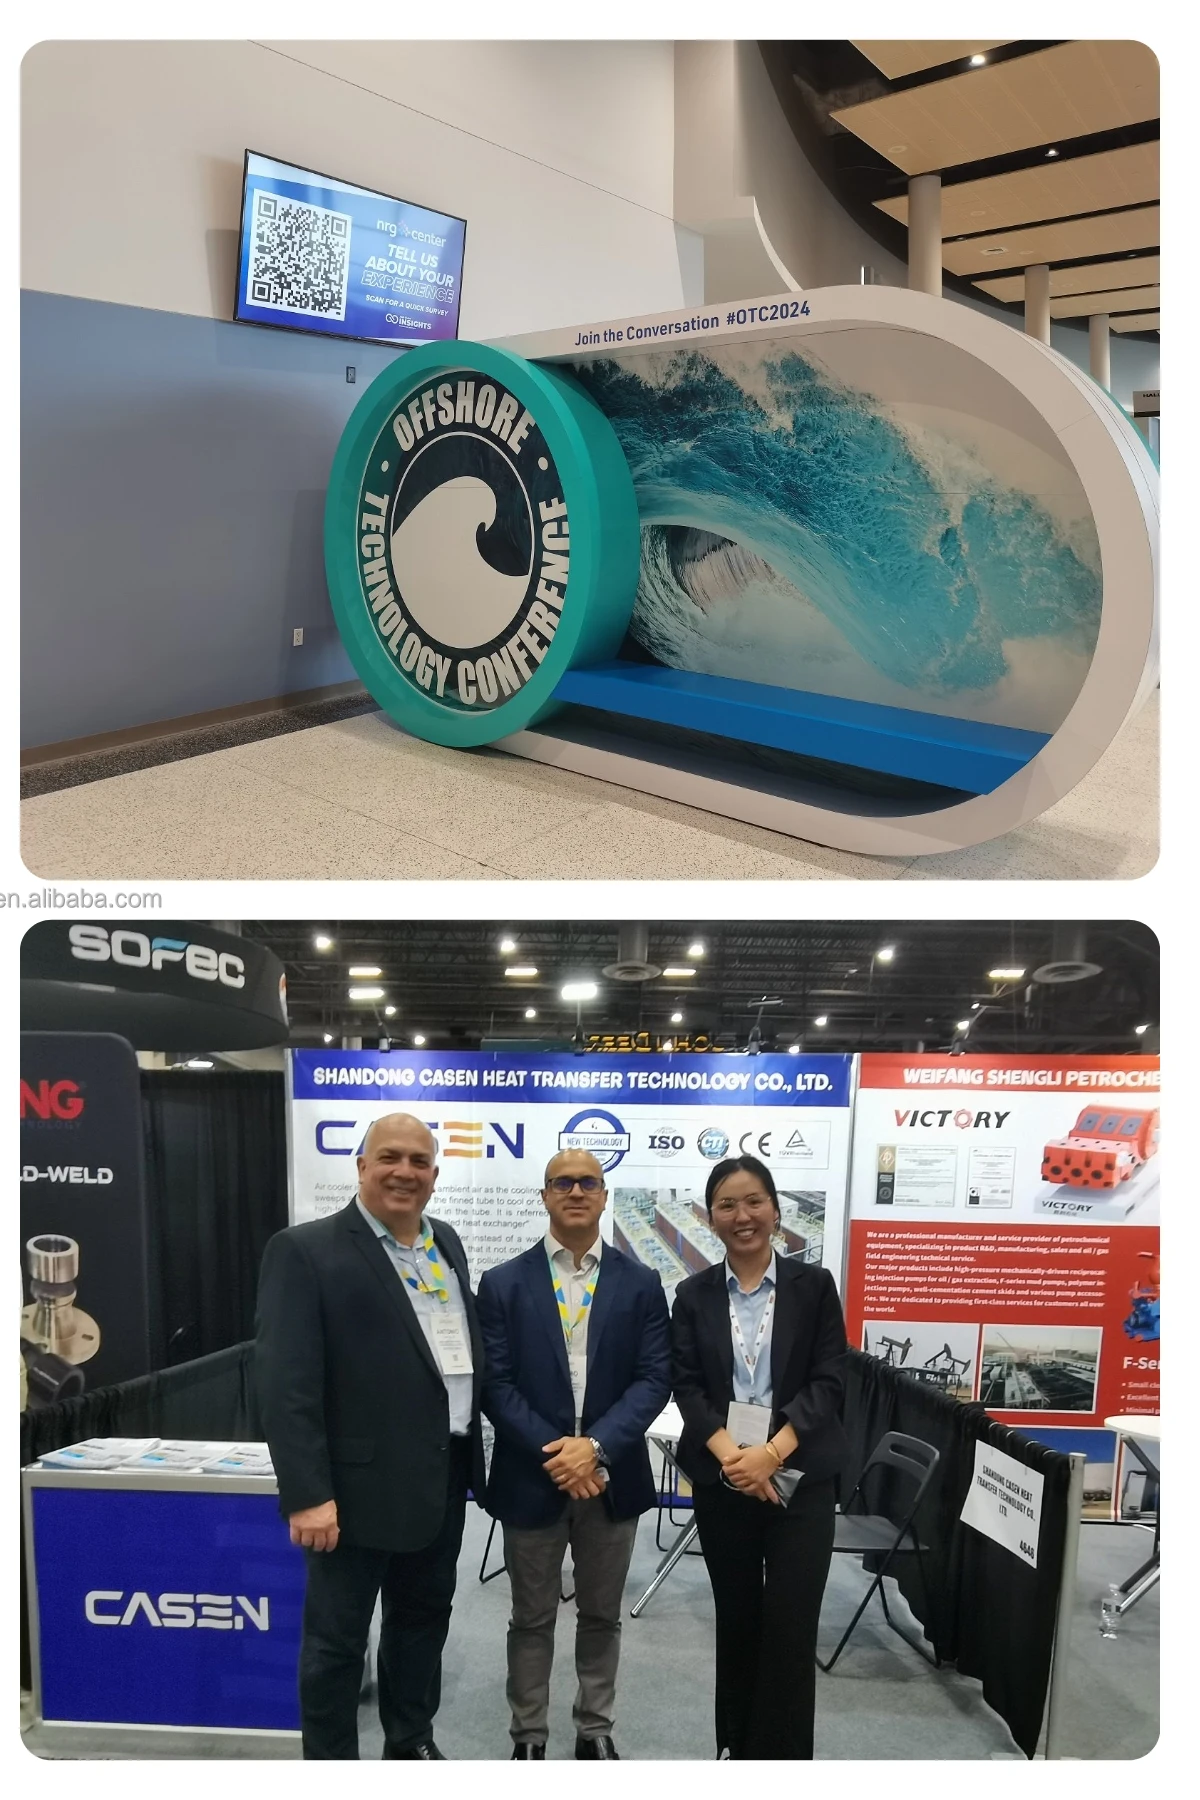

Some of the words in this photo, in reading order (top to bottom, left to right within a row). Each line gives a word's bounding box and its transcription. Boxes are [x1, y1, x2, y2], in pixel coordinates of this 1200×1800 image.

[376, 219, 397, 238] nrg
[411, 229, 446, 247] center
[388, 244, 417, 263] TELL
[421, 252, 439, 268] US
[365, 255, 416, 279] ABOUT
[419, 267, 454, 288] YOUR
[361, 270, 455, 304] EXPERIENCE
[365, 294, 384, 305] SCAN
[385, 298, 399, 307] FOR
[405, 302, 425, 312] QUICK
[426, 306, 449, 317] SURVEY
[575, 332, 600, 346] Join
[603, 328, 624, 343] the
[626, 316, 720, 340] Conversation
[726, 301, 811, 325] #OTC2024
[393, 380, 535, 455] OFFSHORE
[361, 489, 452, 698] TECHNOLOGY
[457, 496, 570, 706] CONFERENCE
[313, 1067, 415, 1087] SHANDONG
[419, 1068, 478, 1087] CASEN
[483, 1070, 527, 1087] HEAT
[531, 1070, 623, 1088] TRANSFER
[627, 1072, 751, 1090] TECHNOLOGY
[754, 1073, 792, 1094] CO.,
[796, 1074, 833, 1091] LTD.
[903, 1068, 983, 1084] WEIFANG
[986, 1068, 1062, 1086] SHENGLI
[894, 1108, 1011, 1129] VICTORY
[315, 1120, 525, 1159] CEN
[567, 1138, 580, 1146] NEW
[583, 1138, 623, 1147] TECHNOLOGY
[649, 1135, 685, 1150] ISO
[702, 1135, 724, 1149] CTI
[739, 1131, 772, 1157] CE
[438, 1185, 470, 1193] ambient
[496, 1186, 509, 1194] the
[511, 1187, 541, 1196] cooling
[449, 1196, 474, 1204] finned
[477, 1197, 495, 1205] tube
[507, 1197, 524, 1205] cool
[1042, 1200, 1093, 1212] VICTORY
[456, 1207, 469, 1215] the
[517, 1209, 549, 1217] referred
[463, 1219, 481, 1227] heat
[473, 1234, 501, 1242] instead
[1022, 1235, 1052, 1243] provider
[468, 1245, 483, 1253] that
[866, 1242, 904, 1250] equipment,
[905, 1243, 944, 1251] specializing
[998, 1245, 1049, 1254] manufacturing,
[882, 1253, 920, 1261] engineering
[905, 1275, 927, 1283] pumps
[1001, 1267, 1069, 1275] mechanically-driven
[942, 1297, 973, 1305] providing
[983, 1465, 1005, 1486] SHANDONG
[1006, 1479, 1020, 1496] CASEN
[1021, 1488, 1032, 1503] HEAT
[977, 1476, 997, 1496] TRANSFER
[999, 1488, 1026, 1515] TECHNOLOGY
[85, 1591, 269, 1631] CASEN
